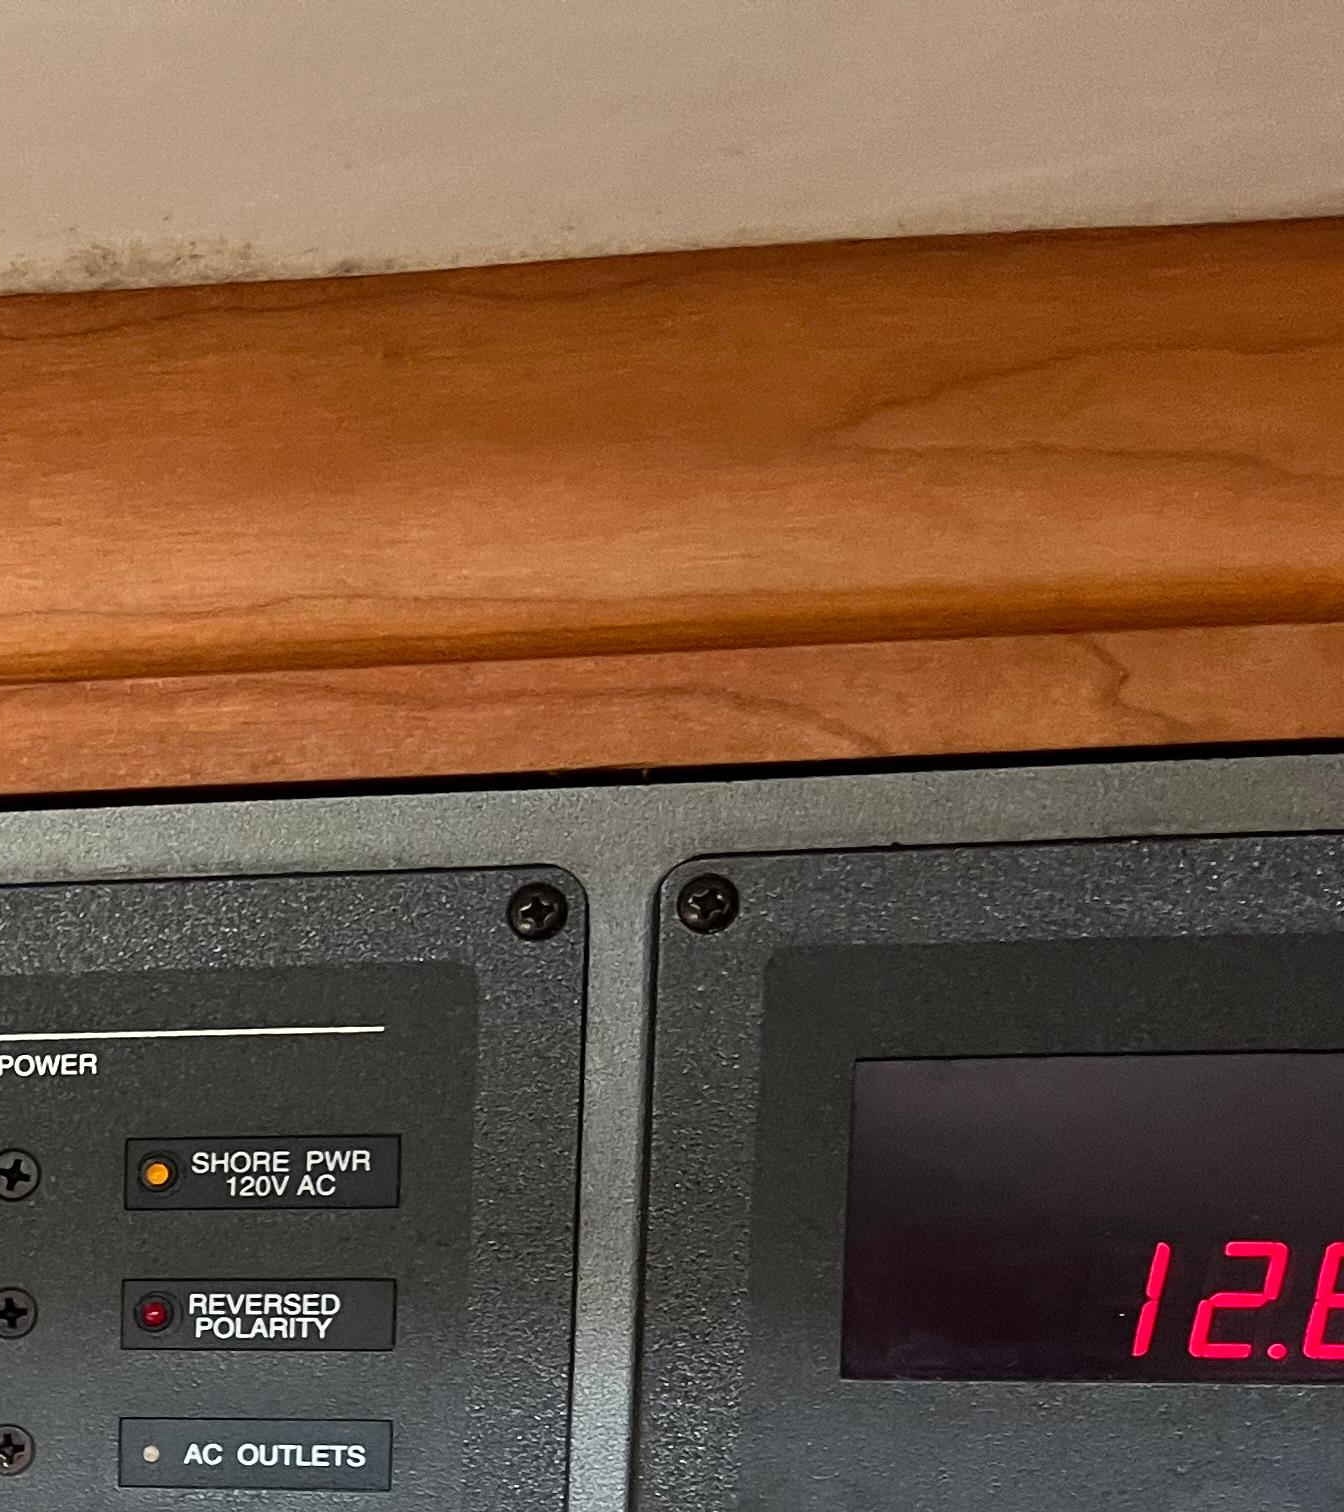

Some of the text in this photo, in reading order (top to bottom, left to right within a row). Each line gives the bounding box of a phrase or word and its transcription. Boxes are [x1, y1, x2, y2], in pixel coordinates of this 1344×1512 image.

[191, 1150, 371, 1174] SHORE PWR
[226, 1174, 336, 1196] 120V AC
[188, 1293, 341, 1315] REVERSED
[195, 1317, 333, 1338] POLARITY
[183, 1443, 366, 1467] AC OUTLETS
